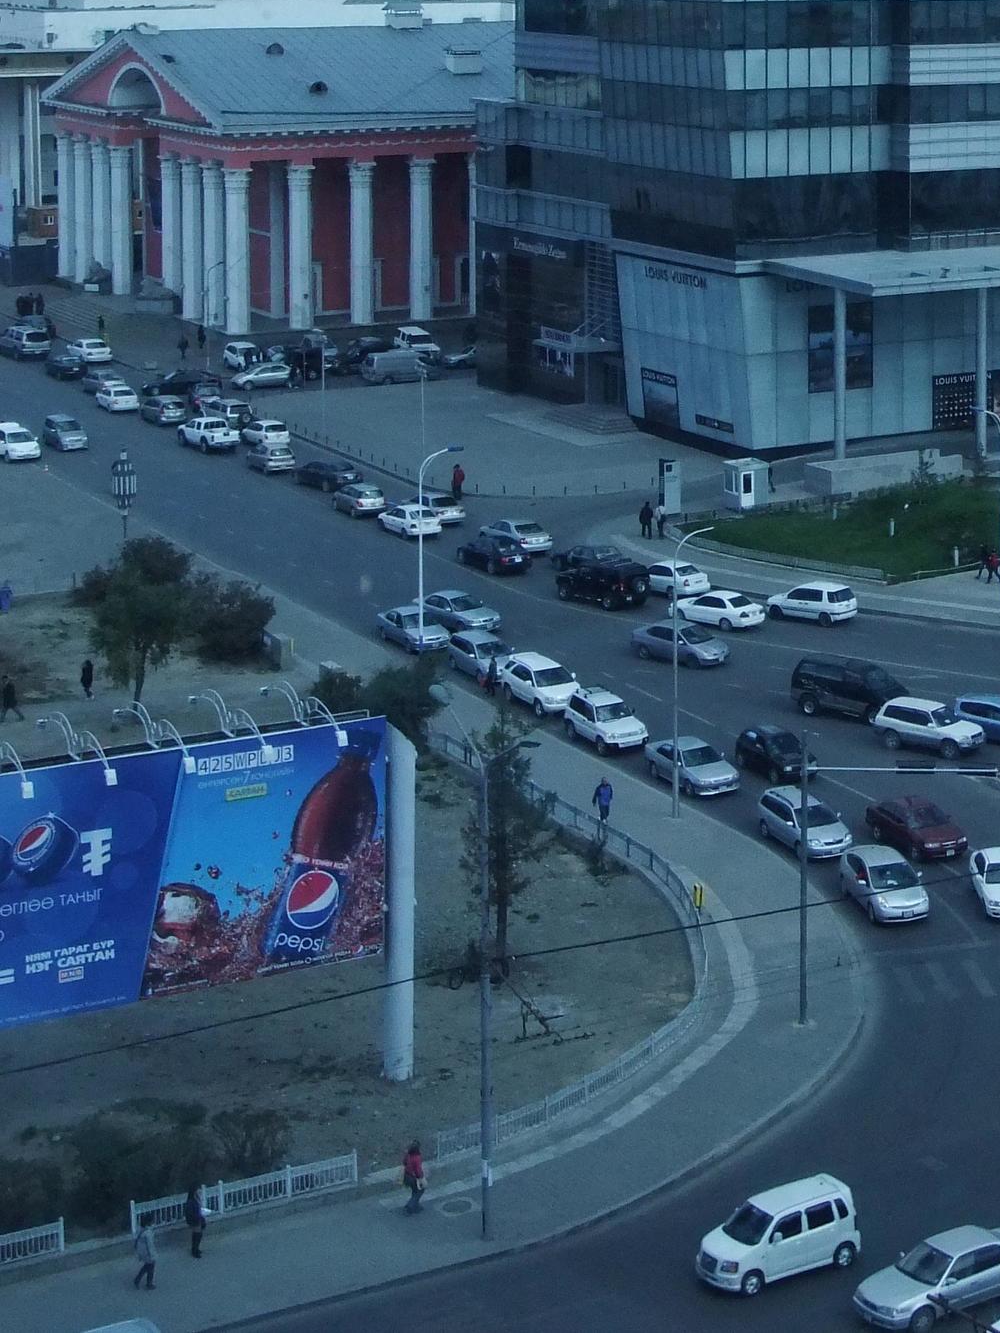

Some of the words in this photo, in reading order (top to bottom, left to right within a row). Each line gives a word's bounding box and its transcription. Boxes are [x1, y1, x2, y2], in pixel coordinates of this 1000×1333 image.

[644, 265, 668, 282] LOUIS
[935, 376, 958, 386] LOUIS
[59, 888, 104, 906] ТАНЫГ
[274, 932, 324, 952] pepsi
[25, 951, 51, 963] НЯМ
[54, 944, 90, 958] ГАРАГ
[25, 960, 54, 974] НЭГ
[57, 949, 115, 968] САЯТАН
